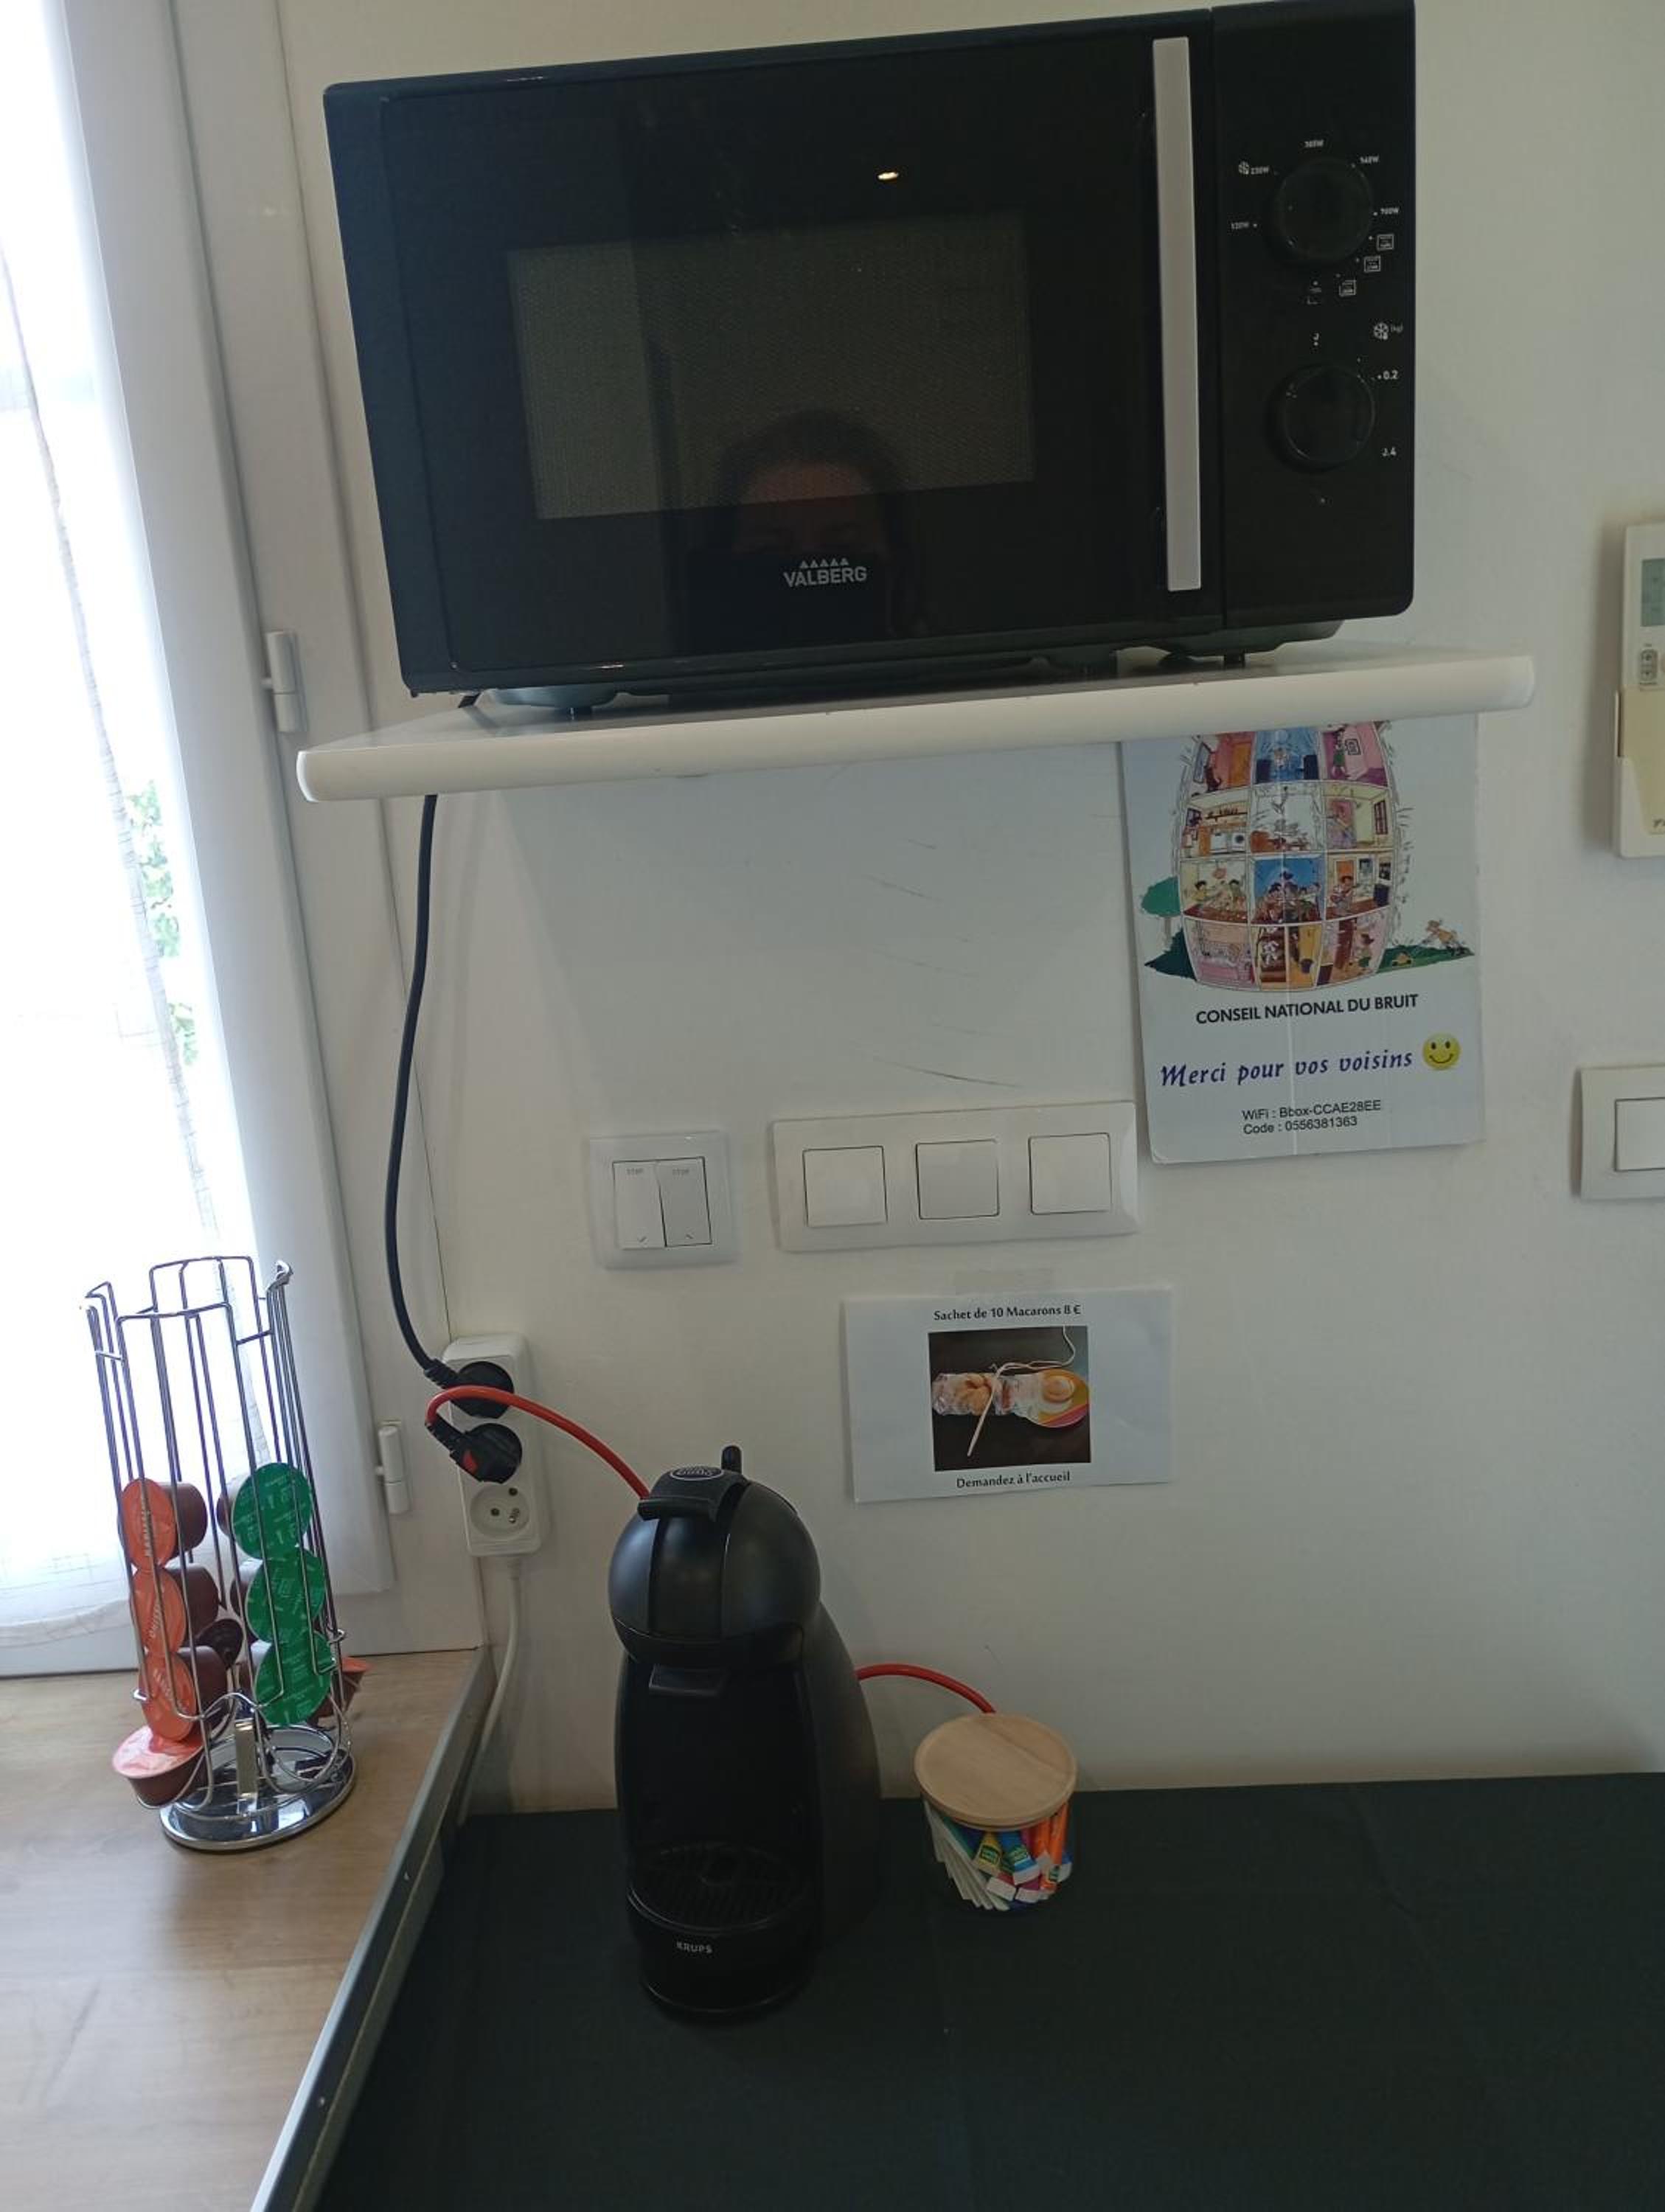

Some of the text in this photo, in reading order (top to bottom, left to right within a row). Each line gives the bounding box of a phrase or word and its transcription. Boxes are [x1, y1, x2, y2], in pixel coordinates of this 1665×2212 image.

[782, 566, 867, 588] VALBERG
[1196, 993, 1419, 1024] CONSEIL NATIONAL DU BRUIT
[1160, 1049, 1413, 1087] Merci pour vos voisins
[1242, 1109, 1269, 1120] WiFi
[1279, 1099, 1382, 1118] Bbox-CCAE28EE
[1242, 1123, 1275, 1135] Code
[1285, 1116, 1358, 1131] 0556381363
[934, 1304, 1081, 1321] Sachet de 10 Macarons 8 €
[956, 1471, 1071, 1488] Demandez à l'accueil
[675, 1941, 713, 1954] KRUPS
